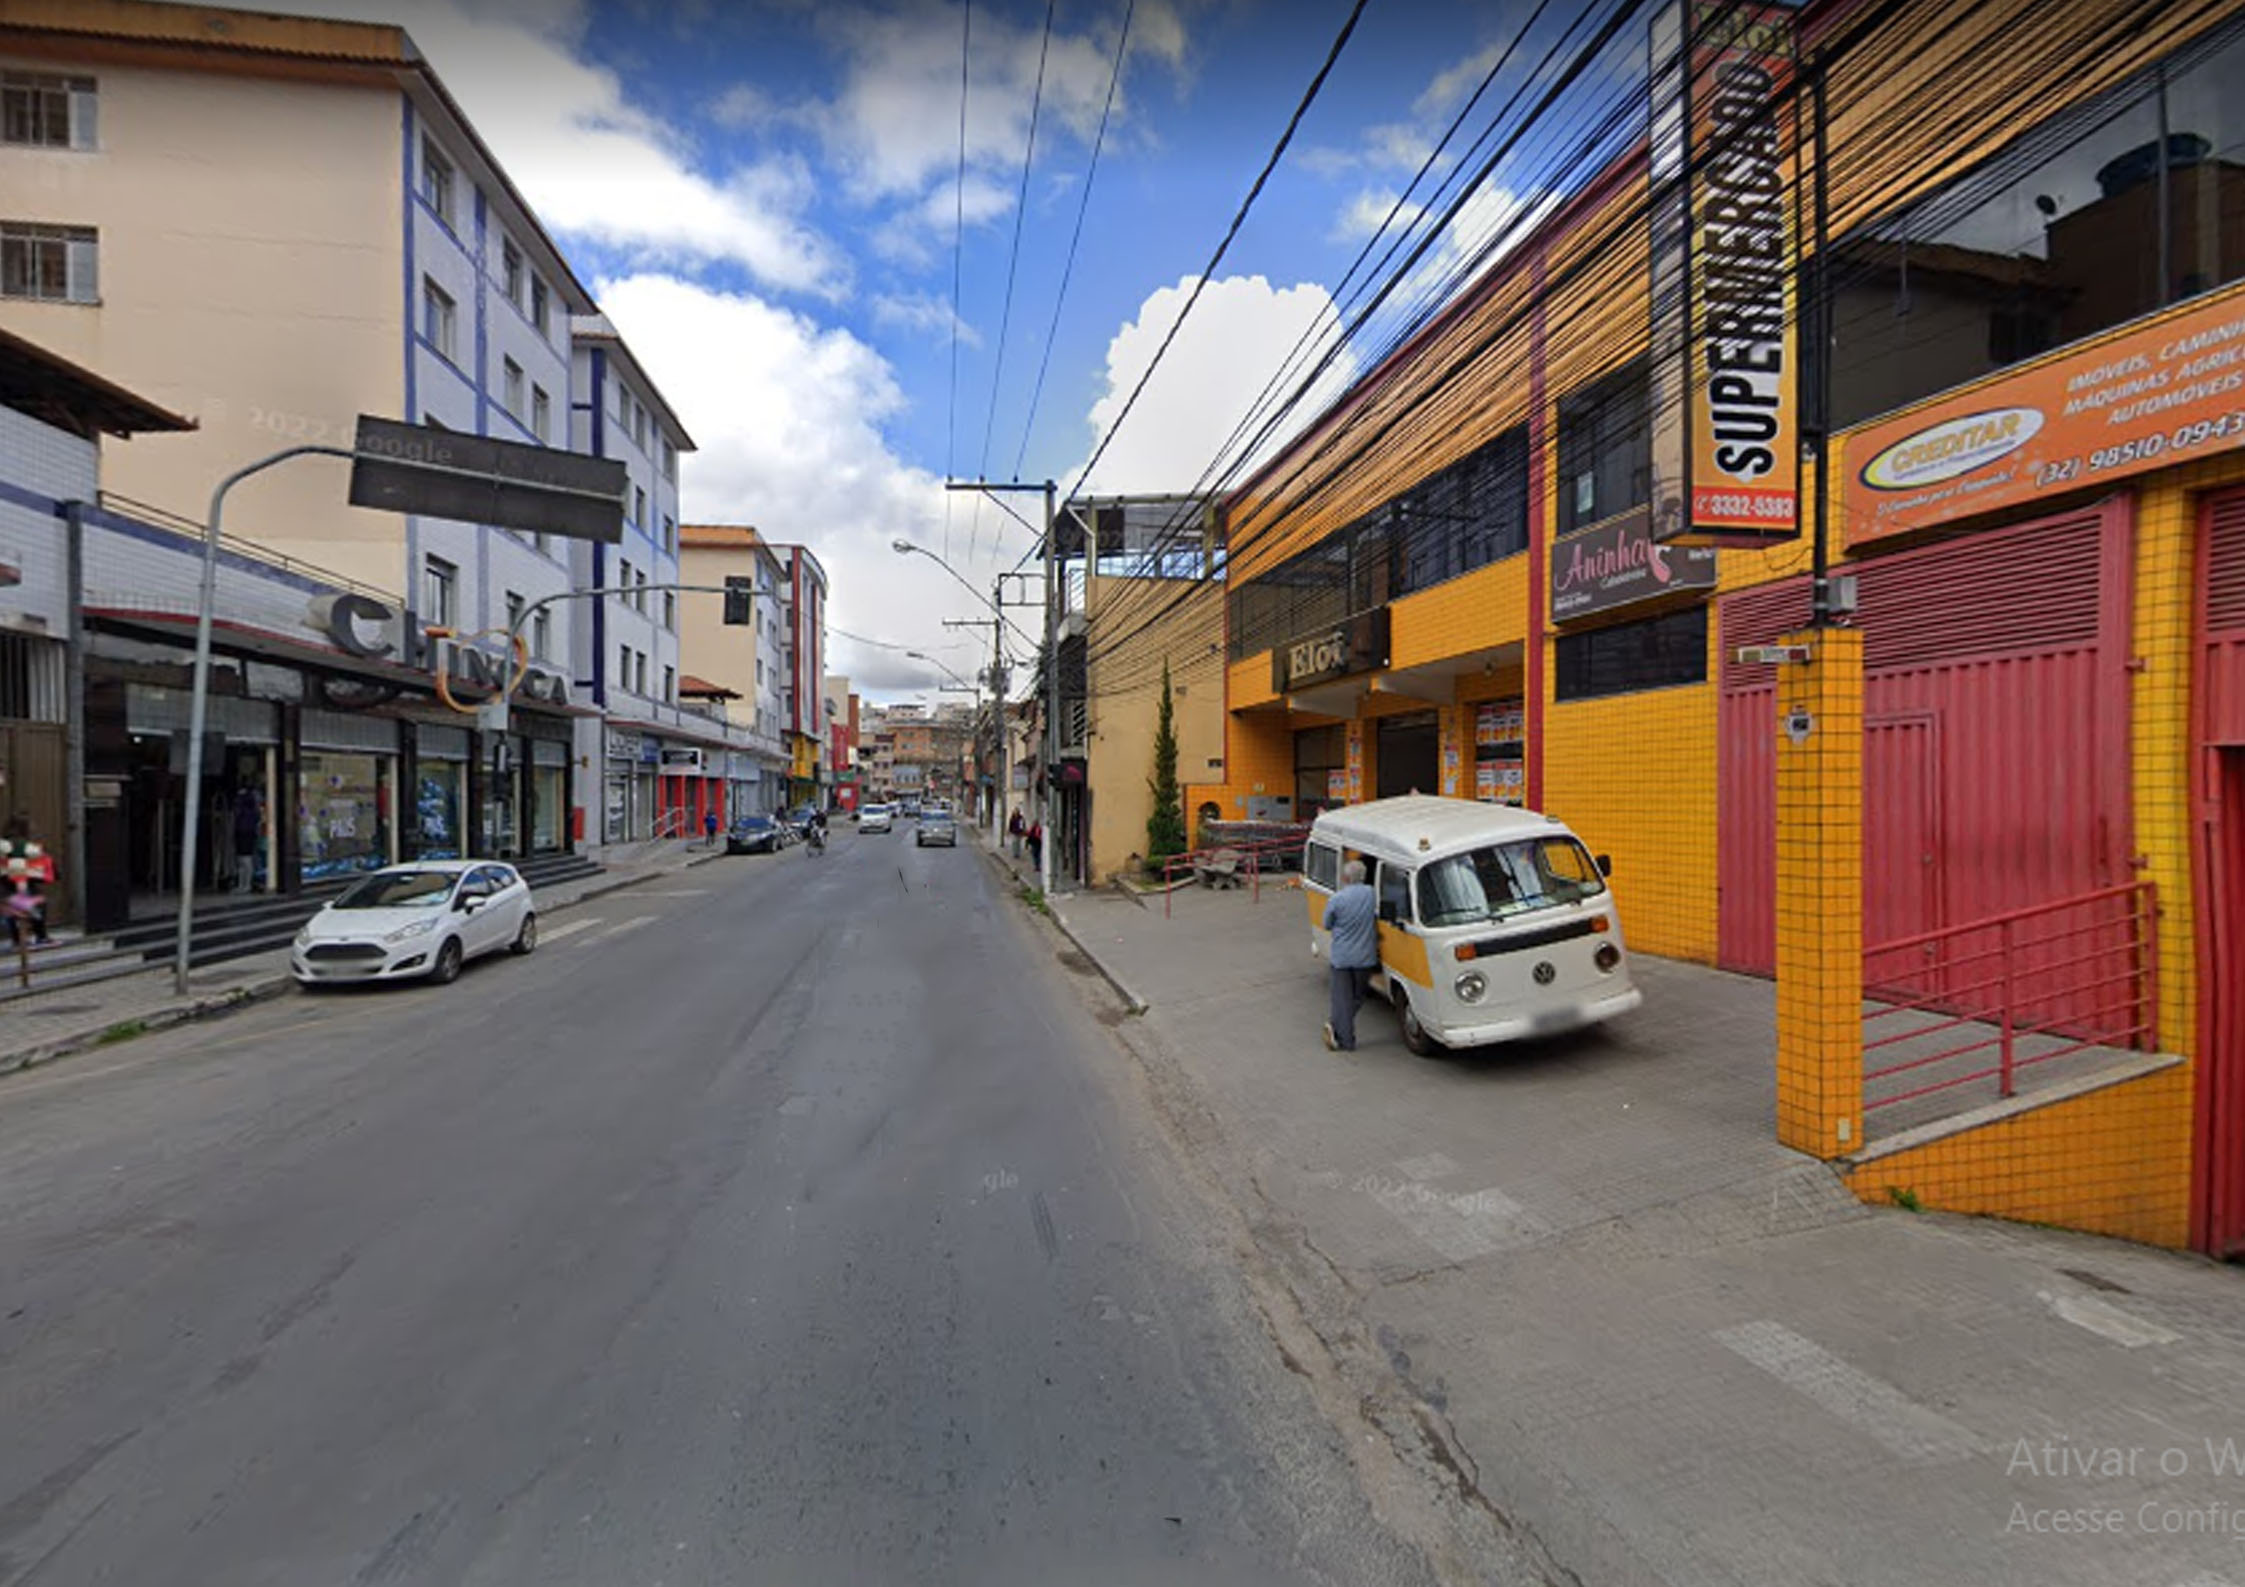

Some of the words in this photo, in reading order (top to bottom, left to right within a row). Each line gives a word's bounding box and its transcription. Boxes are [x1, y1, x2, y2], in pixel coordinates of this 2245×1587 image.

[1704, 60, 1784, 477] SUPERMERCADO
[1891, 412, 2022, 472] CREDITAR
[2035, 457, 2082, 488] (32)
[1554, 529, 1652, 591] Aninha
